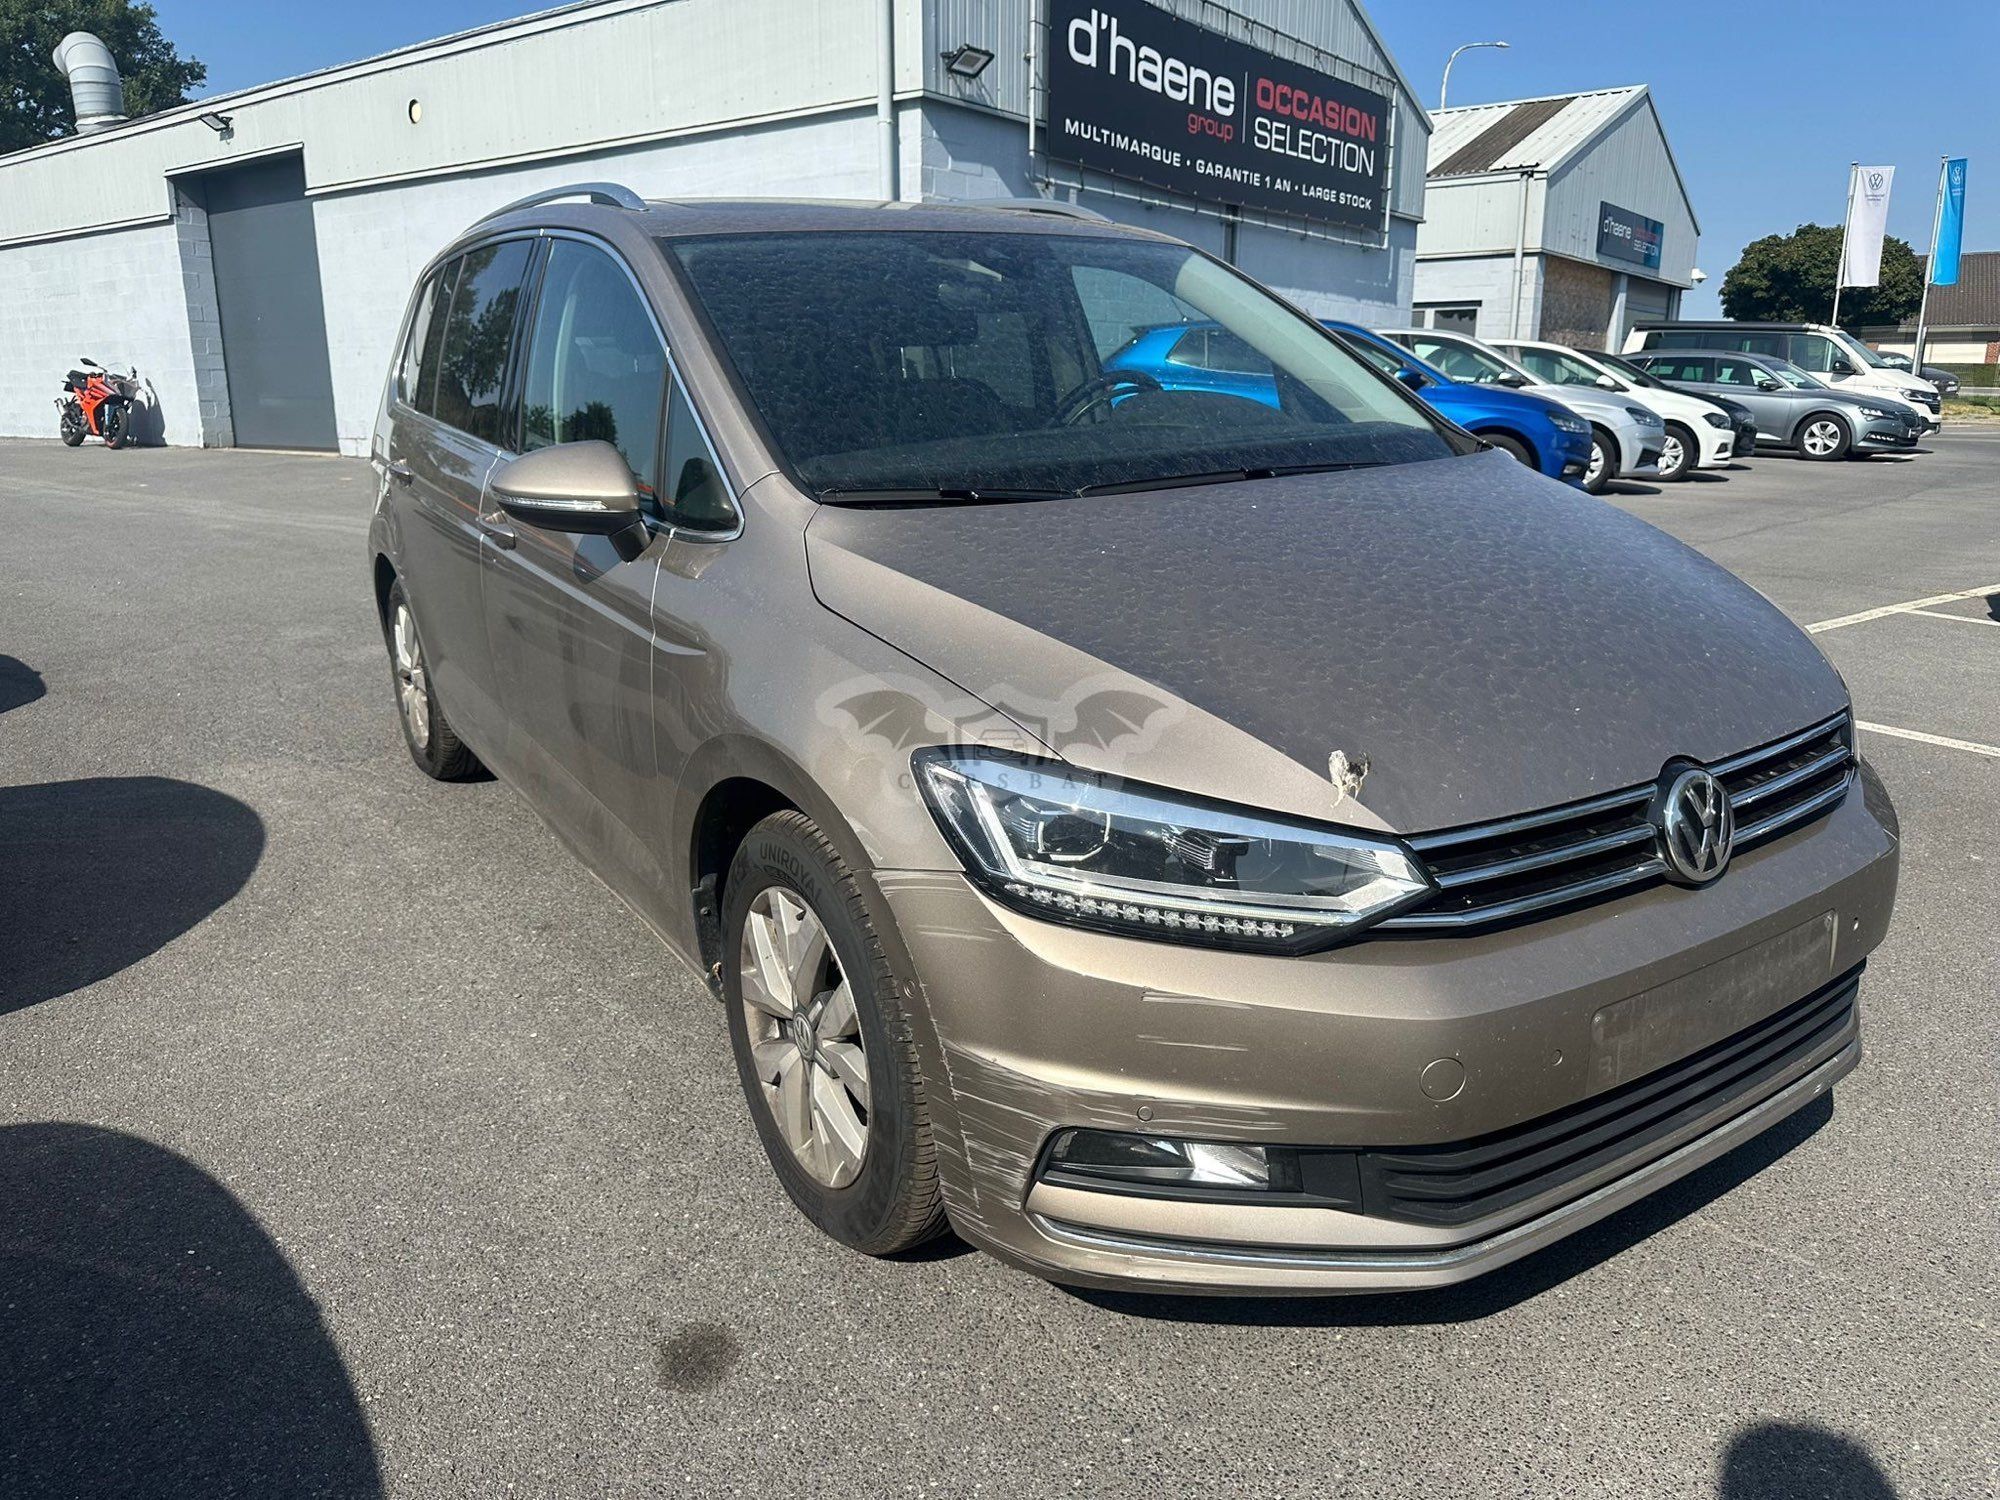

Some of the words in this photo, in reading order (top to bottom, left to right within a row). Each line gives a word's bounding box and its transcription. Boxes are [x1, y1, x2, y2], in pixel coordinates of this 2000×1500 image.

[1068, 8, 1235, 117] d'haene
[1187, 113, 1233, 142] group
[1256, 78, 1376, 142] OCCASION
[1065, 118, 1181, 167] MULTIMARQUE
[1196, 160, 1261, 187] GARANTIE
[1264, 175, 1271, 189] 1
[1274, 178, 1291, 192] AN
[1302, 184, 1337, 202] LARGE
[1339, 192, 1372, 210] STOCK
[1254, 116, 1375, 177] SELECTION
[759, 842, 823, 902] UNIROYAL
